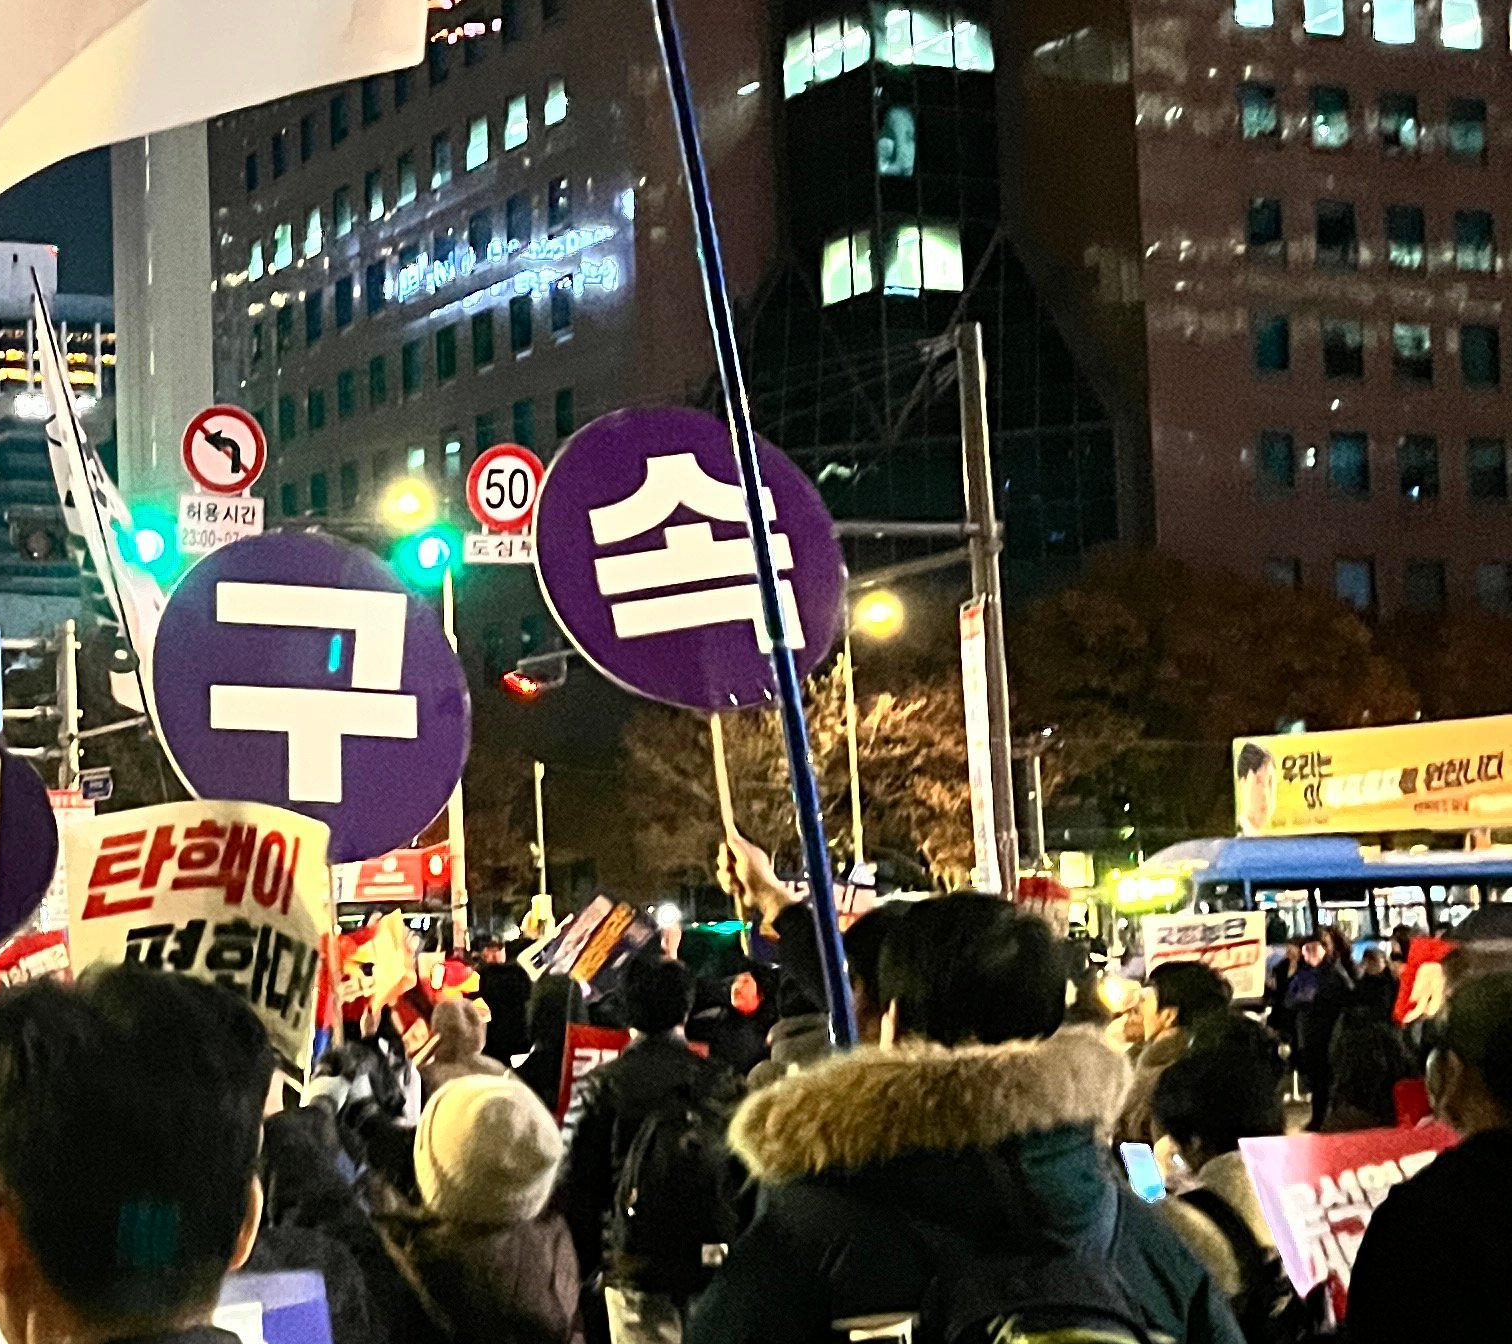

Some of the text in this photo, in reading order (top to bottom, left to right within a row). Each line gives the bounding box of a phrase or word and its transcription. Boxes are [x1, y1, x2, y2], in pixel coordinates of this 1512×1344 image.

[485, 468, 529, 509] 50
[588, 452, 806, 654] 속
[209, 580, 418, 804] 구
[81, 818, 301, 921] 탄핵이
